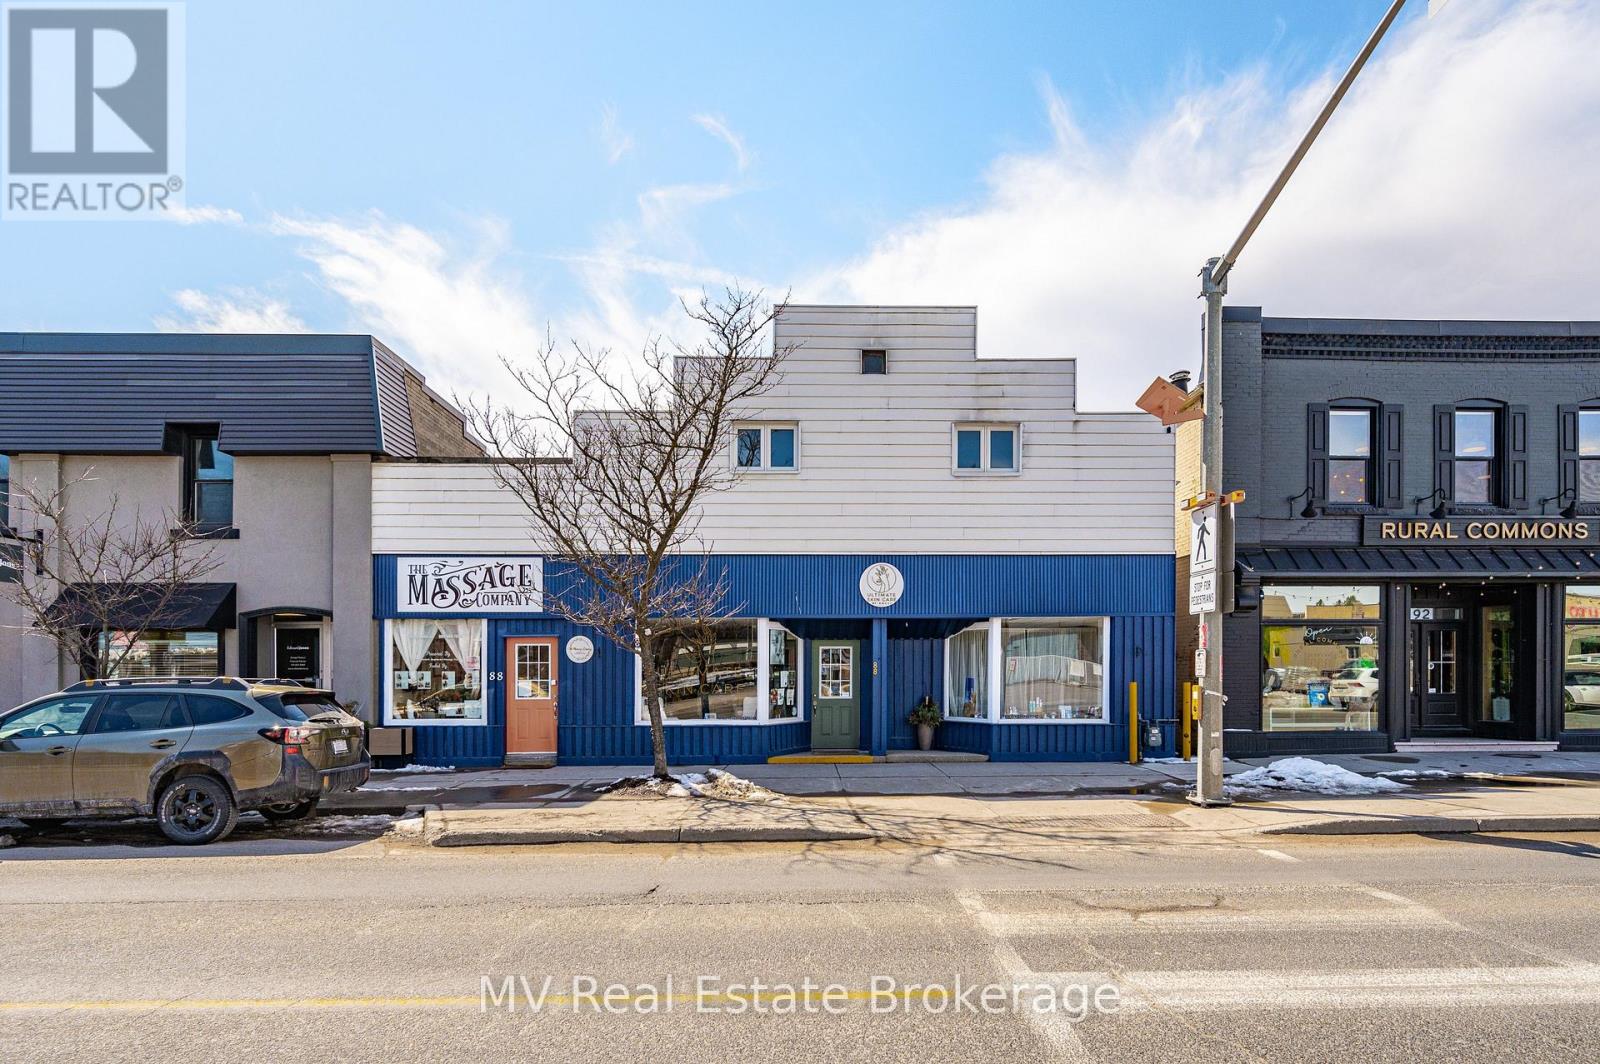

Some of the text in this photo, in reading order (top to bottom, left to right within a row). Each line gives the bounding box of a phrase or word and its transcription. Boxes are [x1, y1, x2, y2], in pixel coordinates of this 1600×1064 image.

[1381, 522, 1589, 539] RURAL COMMONS
[407, 564, 428, 574] THE
[407, 563, 532, 608] MASSAGE
[1193, 580, 1211, 593] STOP FOR
[476, 591, 532, 607] COMPANY
[1413, 609, 1430, 619] 92
[1305, 627, 1333, 641] Open
[489, 671, 503, 681] 88
